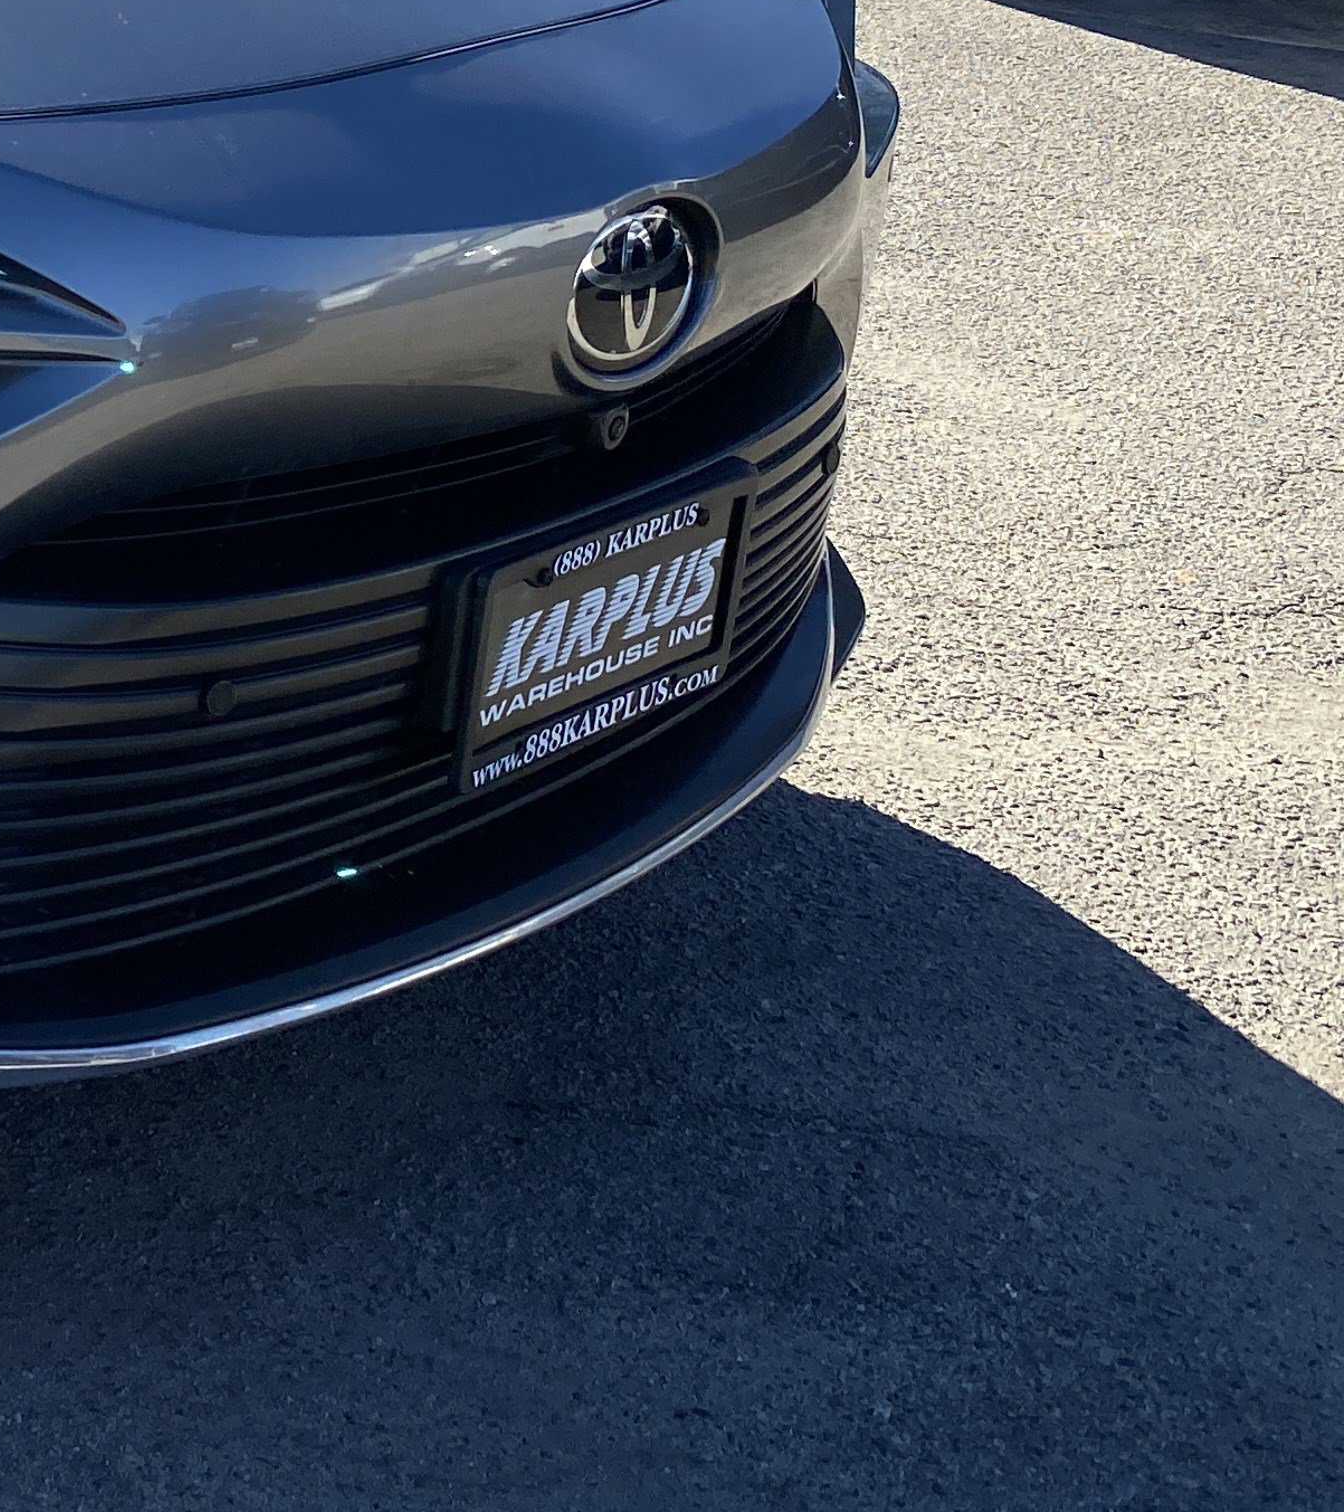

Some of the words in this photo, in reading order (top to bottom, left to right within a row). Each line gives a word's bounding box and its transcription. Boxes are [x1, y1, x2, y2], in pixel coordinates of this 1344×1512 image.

[552, 539, 601, 577] (888)
[604, 502, 700, 559] KARPLUS
[479, 637, 660, 727] WAREHOUSE
[667, 613, 714, 649] INC
[484, 537, 727, 698] KARPLUS
